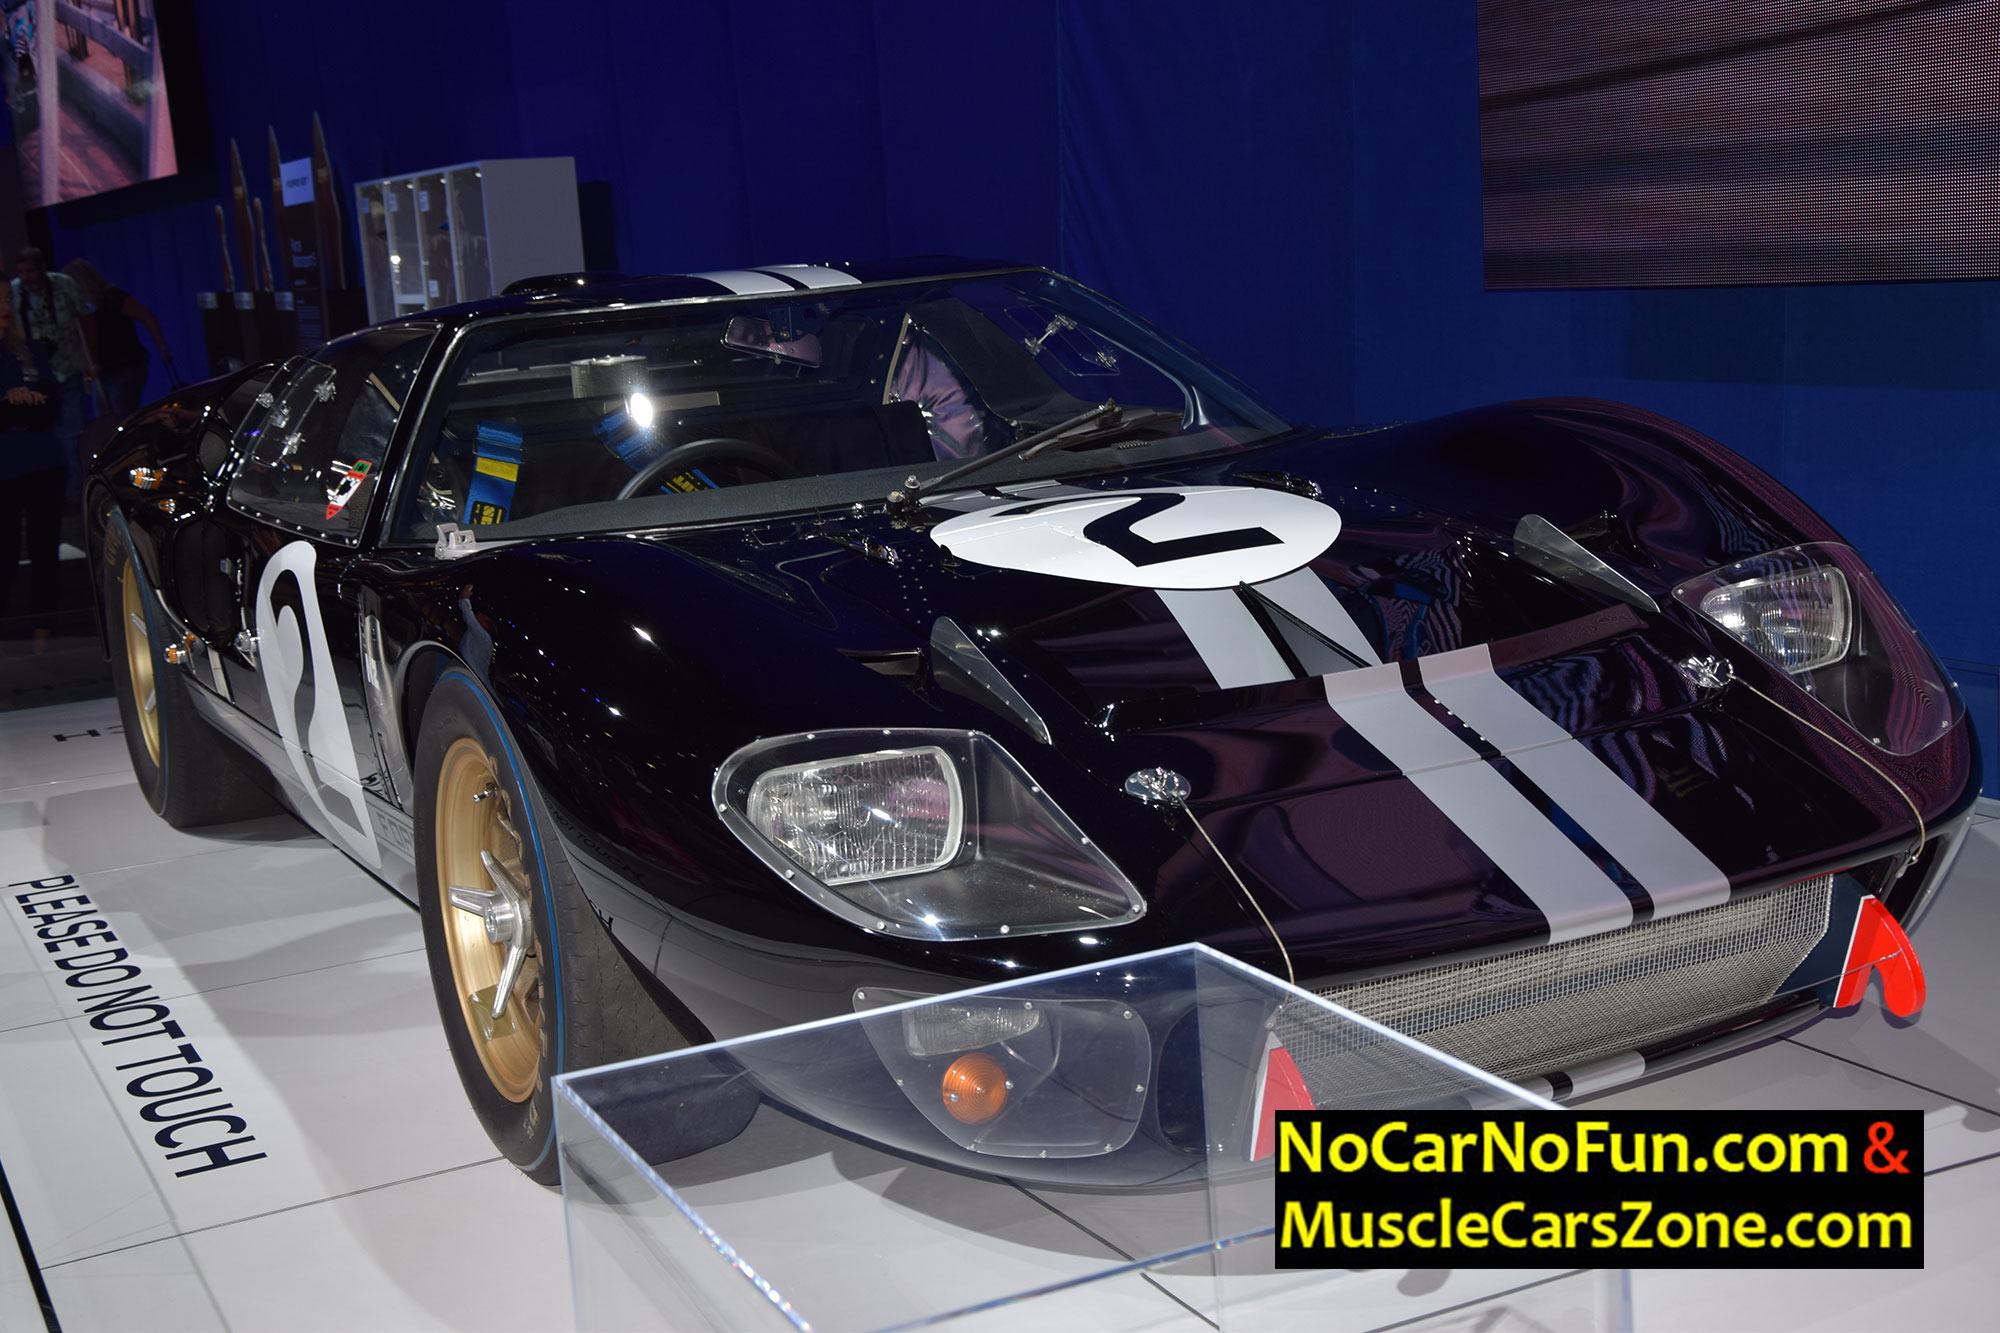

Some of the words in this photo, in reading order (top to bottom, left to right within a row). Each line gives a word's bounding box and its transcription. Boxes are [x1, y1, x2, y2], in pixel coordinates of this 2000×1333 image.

[990, 492, 1284, 567] 2
[270, 569, 367, 838] 2
[376, 811, 414, 851] FOR
[8, 874, 118, 954] PLEASE
[54, 947, 142, 988] DO
[77, 984, 186, 1046] NOT
[115, 1043, 268, 1178] TOUCH
